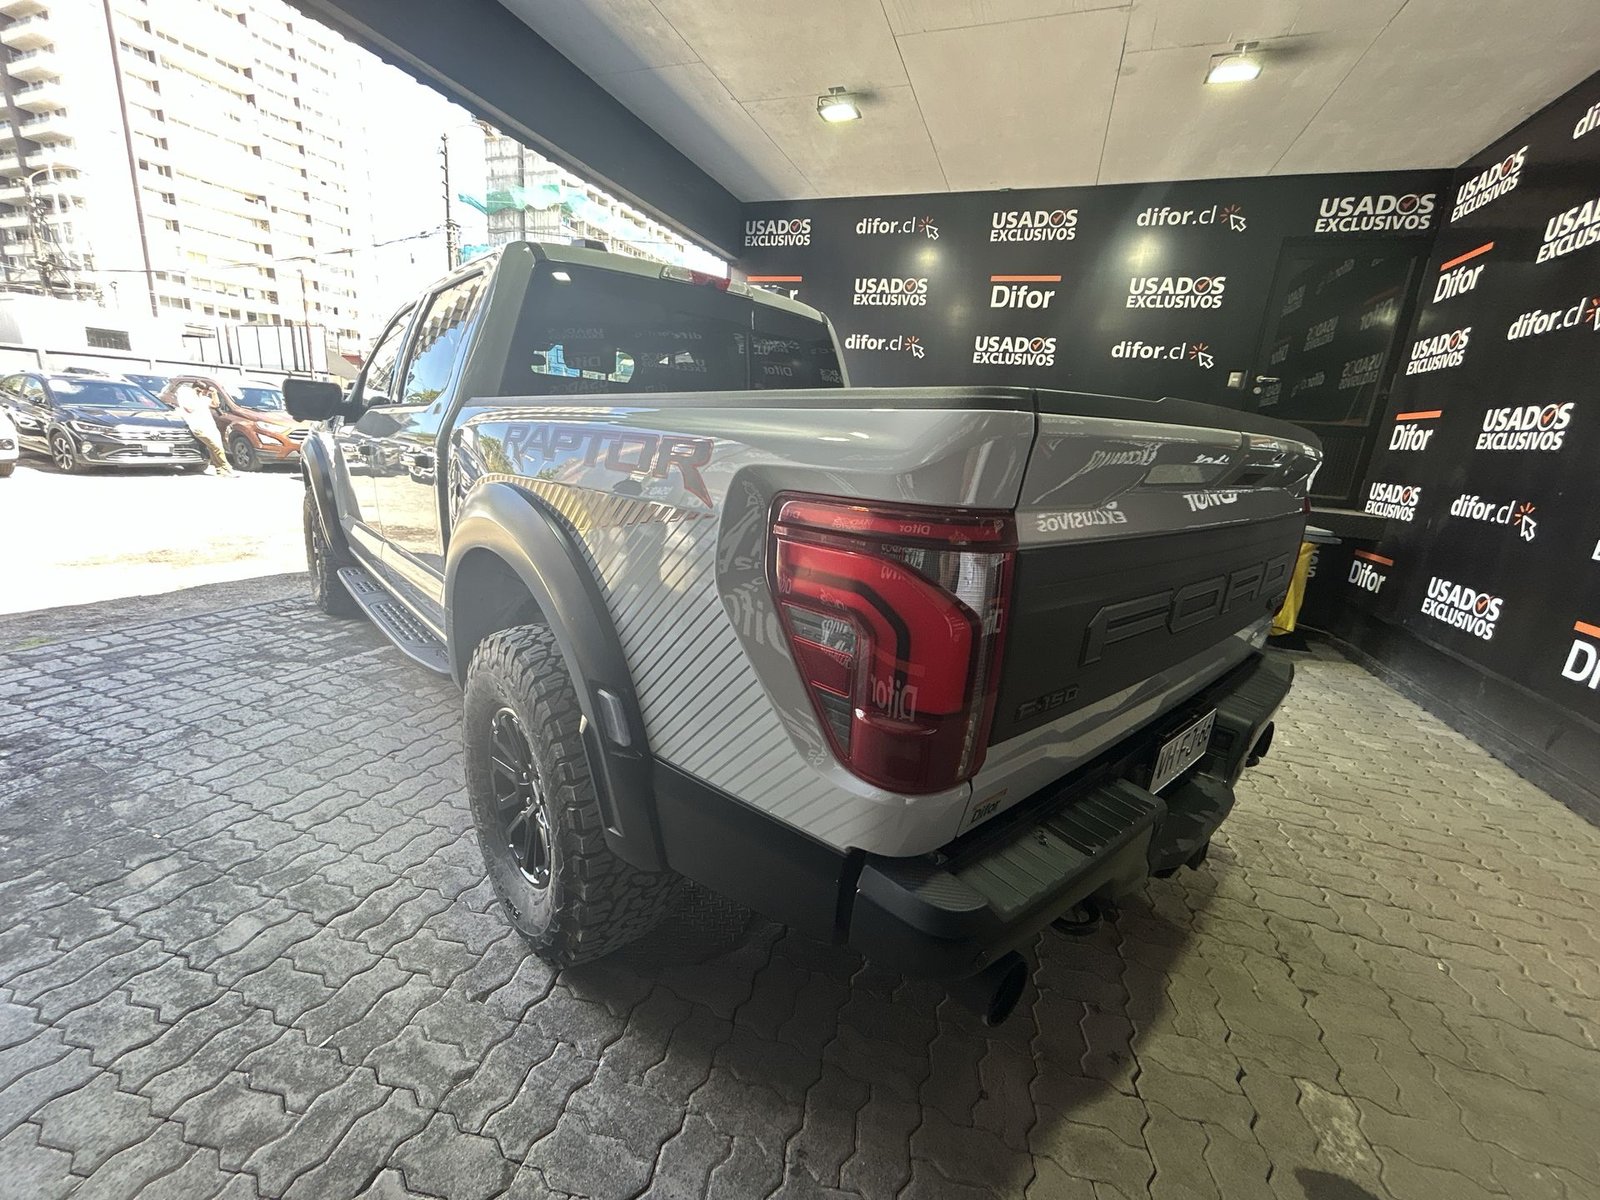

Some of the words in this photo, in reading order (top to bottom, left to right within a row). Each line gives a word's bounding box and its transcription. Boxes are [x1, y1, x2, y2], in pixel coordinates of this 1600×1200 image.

[1573, 102, 1600, 140] di
[1456, 145, 1528, 205] USADOS
[1320, 193, 1436, 218] USADOS
[1450, 172, 1520, 223] EXCLUSIVOS
[745, 218, 811, 235] USADOS
[855, 217, 916, 235] difor.cl
[992, 209, 1078, 229] USADOS
[1136, 205, 1217, 227] difor.cl
[1314, 215, 1431, 233] EXCLUSIVOS
[744, 234, 811, 247] EXCLUSIVOS
[990, 227, 1076, 242] EXCLUSIVOS
[1535, 222, 1600, 264] EXCLUS
[855, 277, 927, 294] USADOS
[1129, 276, 1226, 296] USADOS
[1433, 264, 1485, 303] Difor
[853, 293, 927, 306] EXCLUSIVOS
[990, 285, 1055, 309] Difor
[1126, 294, 1223, 309] EXCLUSIVOS
[1507, 297, 1588, 341] difor.cl
[844, 334, 903, 351] difor.cl
[975, 336, 1057, 355] USADOS
[1111, 341, 1187, 360] difor.cl
[1411, 327, 1472, 360] USADOS
[972, 351, 1055, 366] EXCLUSIVOS
[1405, 350, 1465, 376] EXCLUSIVOS
[1482, 402, 1575, 433] USADOS
[1389, 423, 1434, 451] Difor
[1475, 430, 1565, 451] EXCLUSIVOS
[503, 425, 714, 509] RAPTOR
[1369, 482, 1421, 506] USADOS
[1364, 500, 1416, 522] EXCLUSIVOS
[1450, 494, 1516, 525] difor.cl
[1348, 560, 1387, 594] Difor
[1078, 551, 1290, 668] FORD
[1427, 576, 1504, 622] USADOS
[1420, 597, 1495, 641] EXCLUSIVOS
